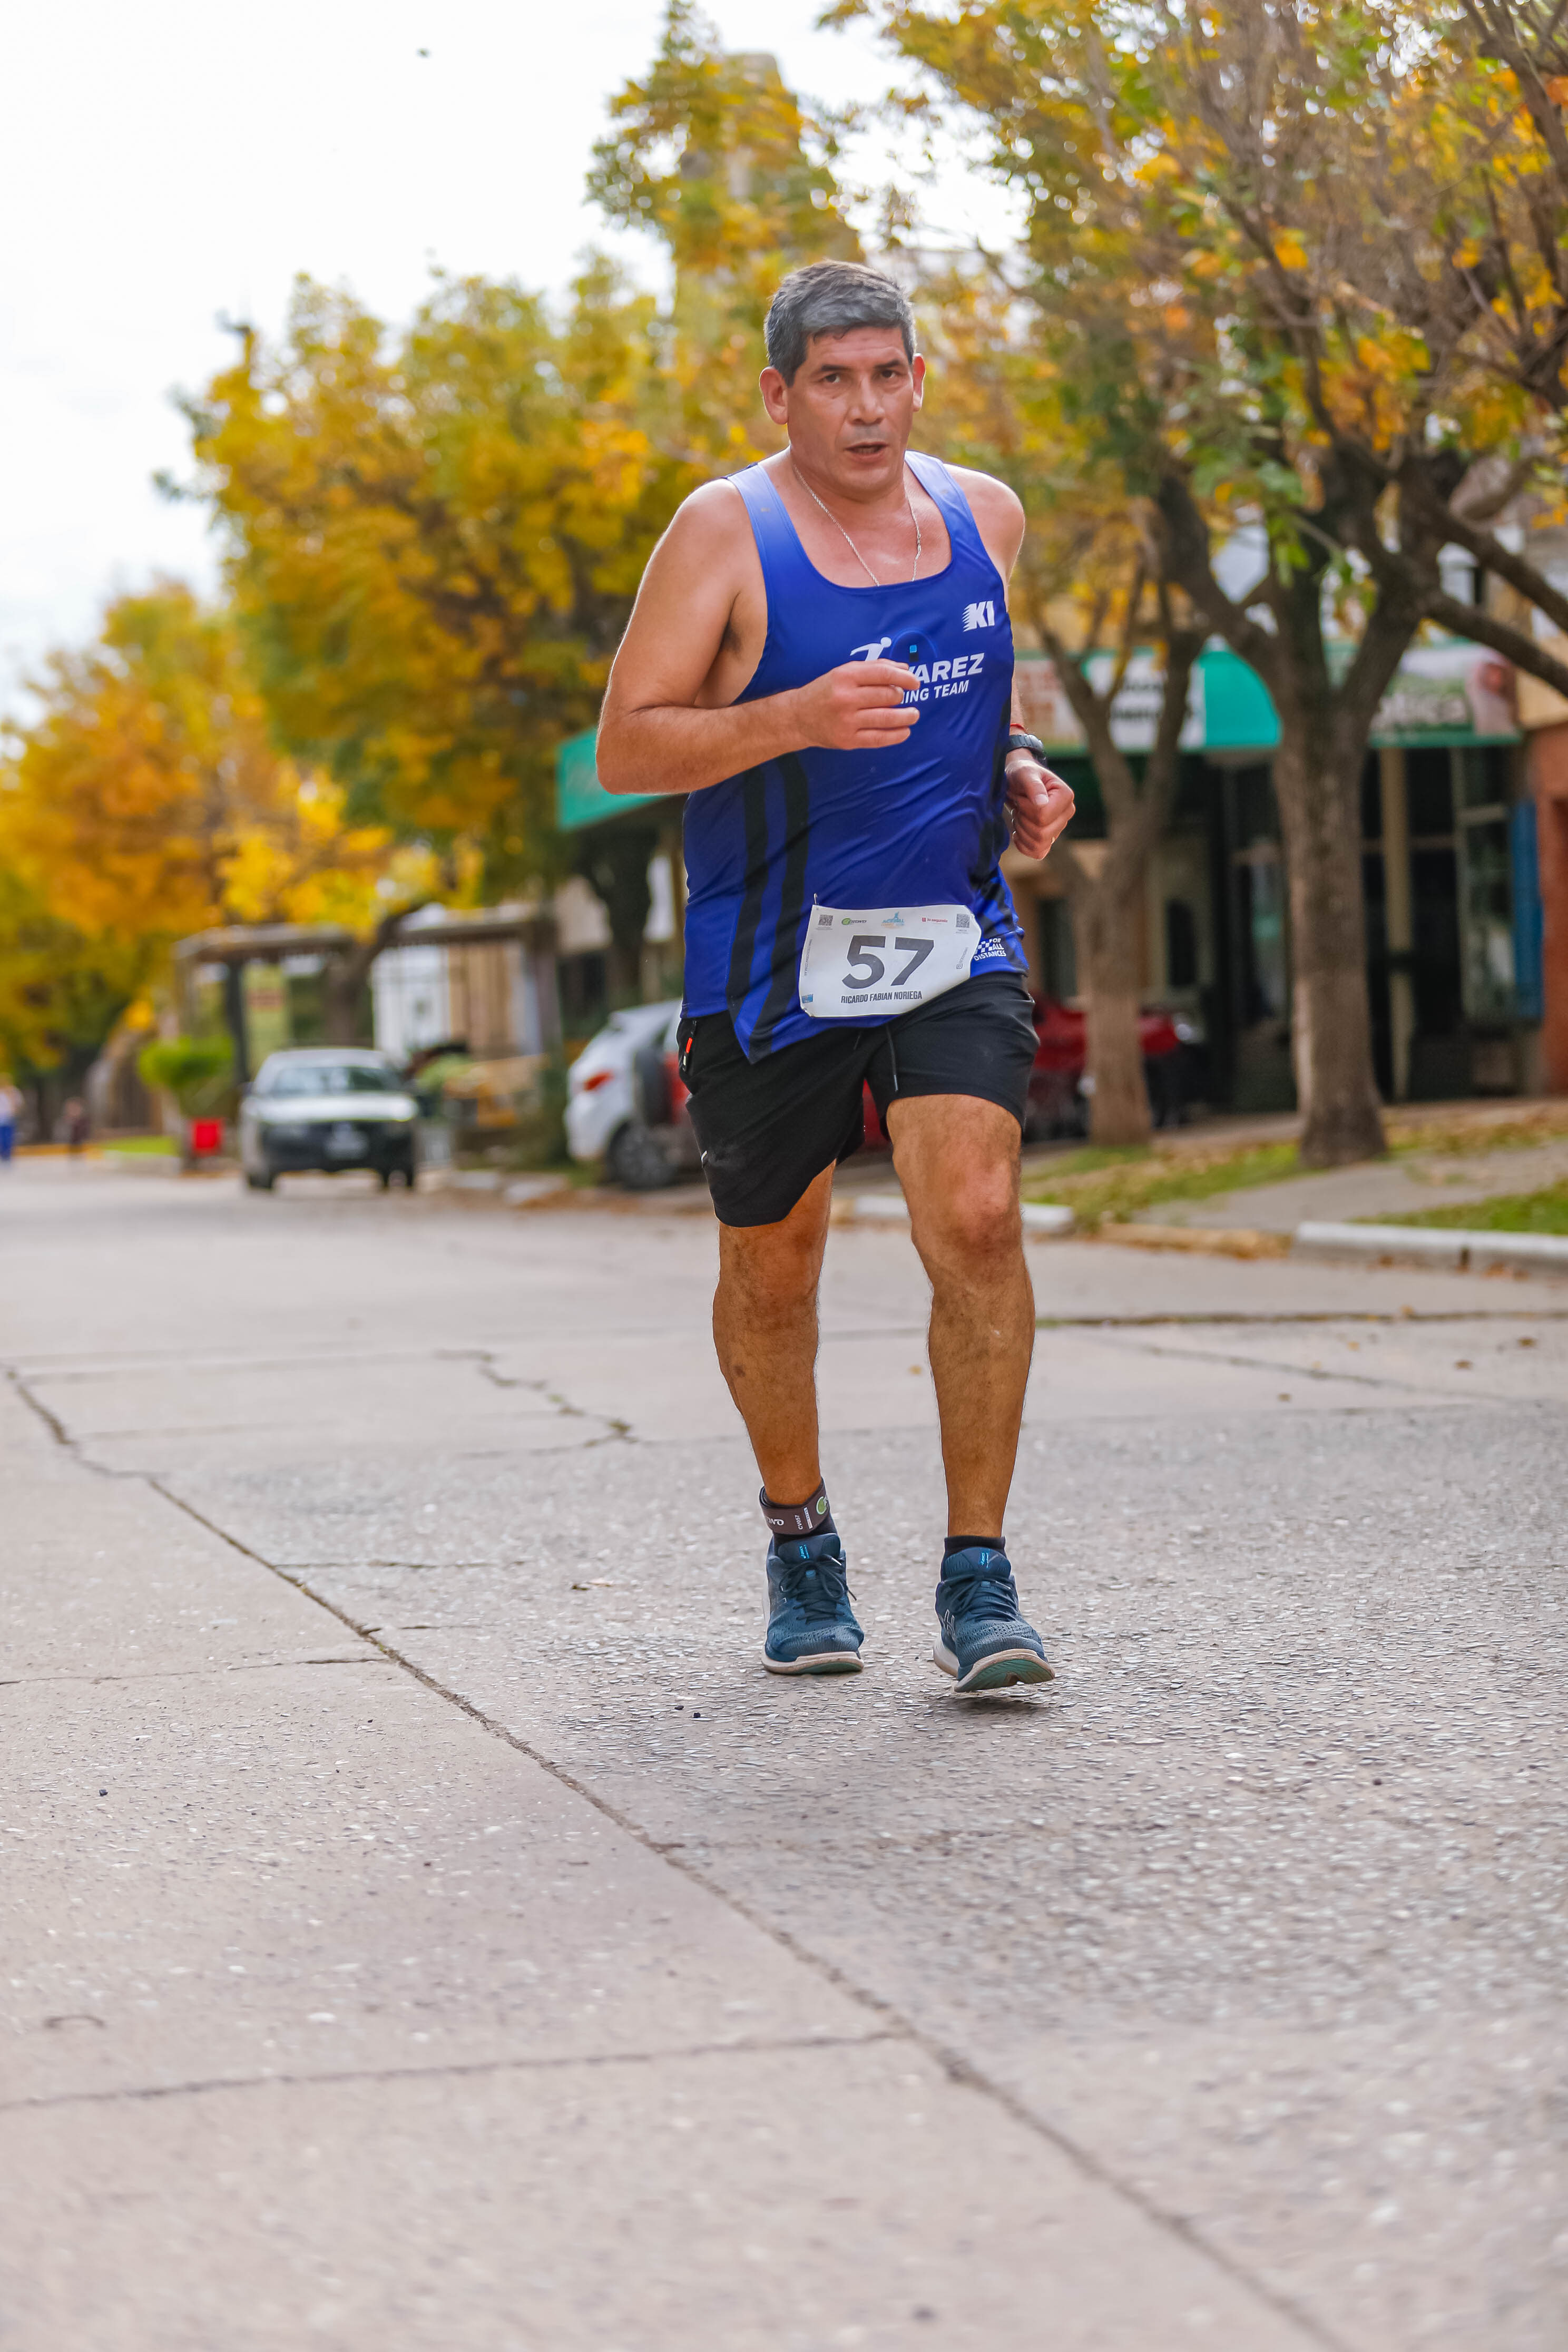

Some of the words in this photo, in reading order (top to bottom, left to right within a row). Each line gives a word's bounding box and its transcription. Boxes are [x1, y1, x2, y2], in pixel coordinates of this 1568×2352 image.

[934, 680, 969, 699] TEAM
[841, 935, 934, 989] 57
[974, 950, 1006, 961] DISTANCES
[841, 994, 868, 1004] RICARDO
[870, 992, 893, 1001] FABIAN
[894, 991, 922, 999] NORIEGA
